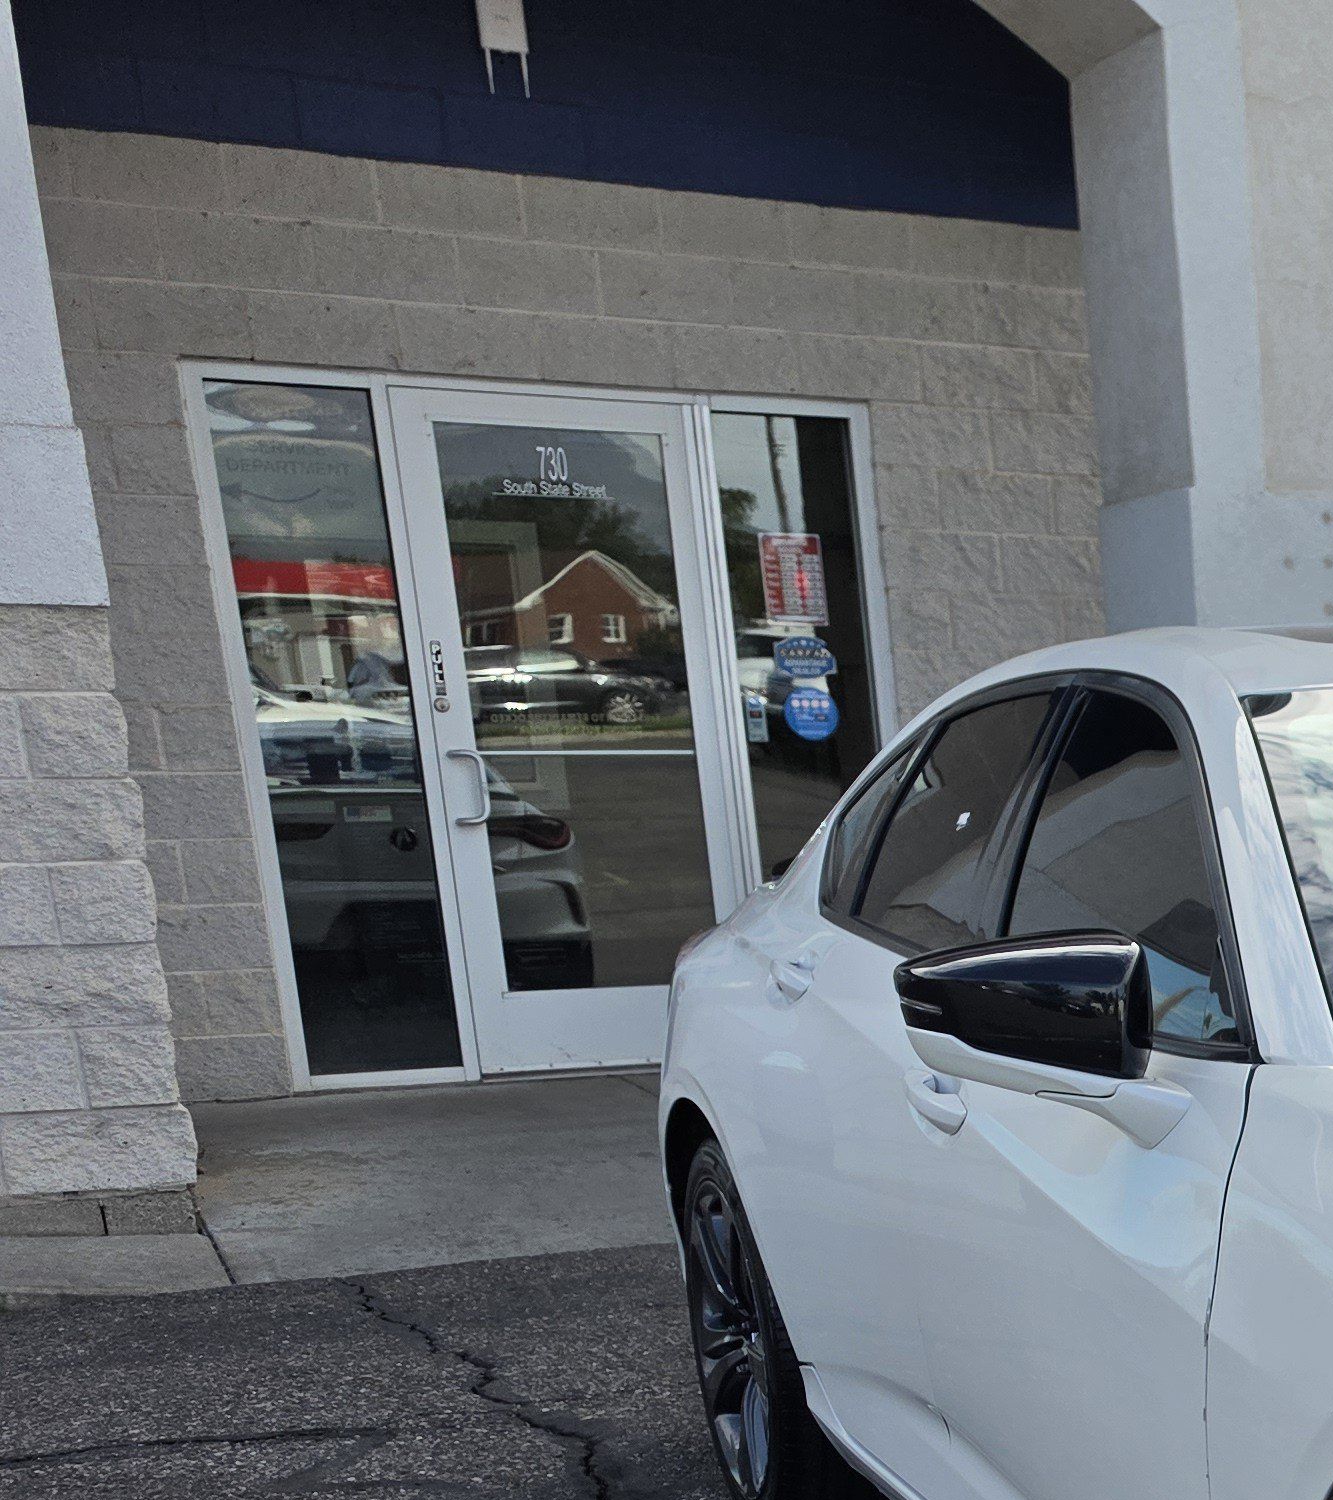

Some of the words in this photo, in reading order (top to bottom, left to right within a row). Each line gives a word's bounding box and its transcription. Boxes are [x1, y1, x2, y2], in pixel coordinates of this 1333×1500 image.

[225, 458, 351, 476] DEPARTMENT
[536, 446, 568, 482] 730
[502, 478, 538, 495] South
[539, 480, 570, 496] State
[572, 482, 607, 498] Street
[431, 644, 444, 684] PULL
